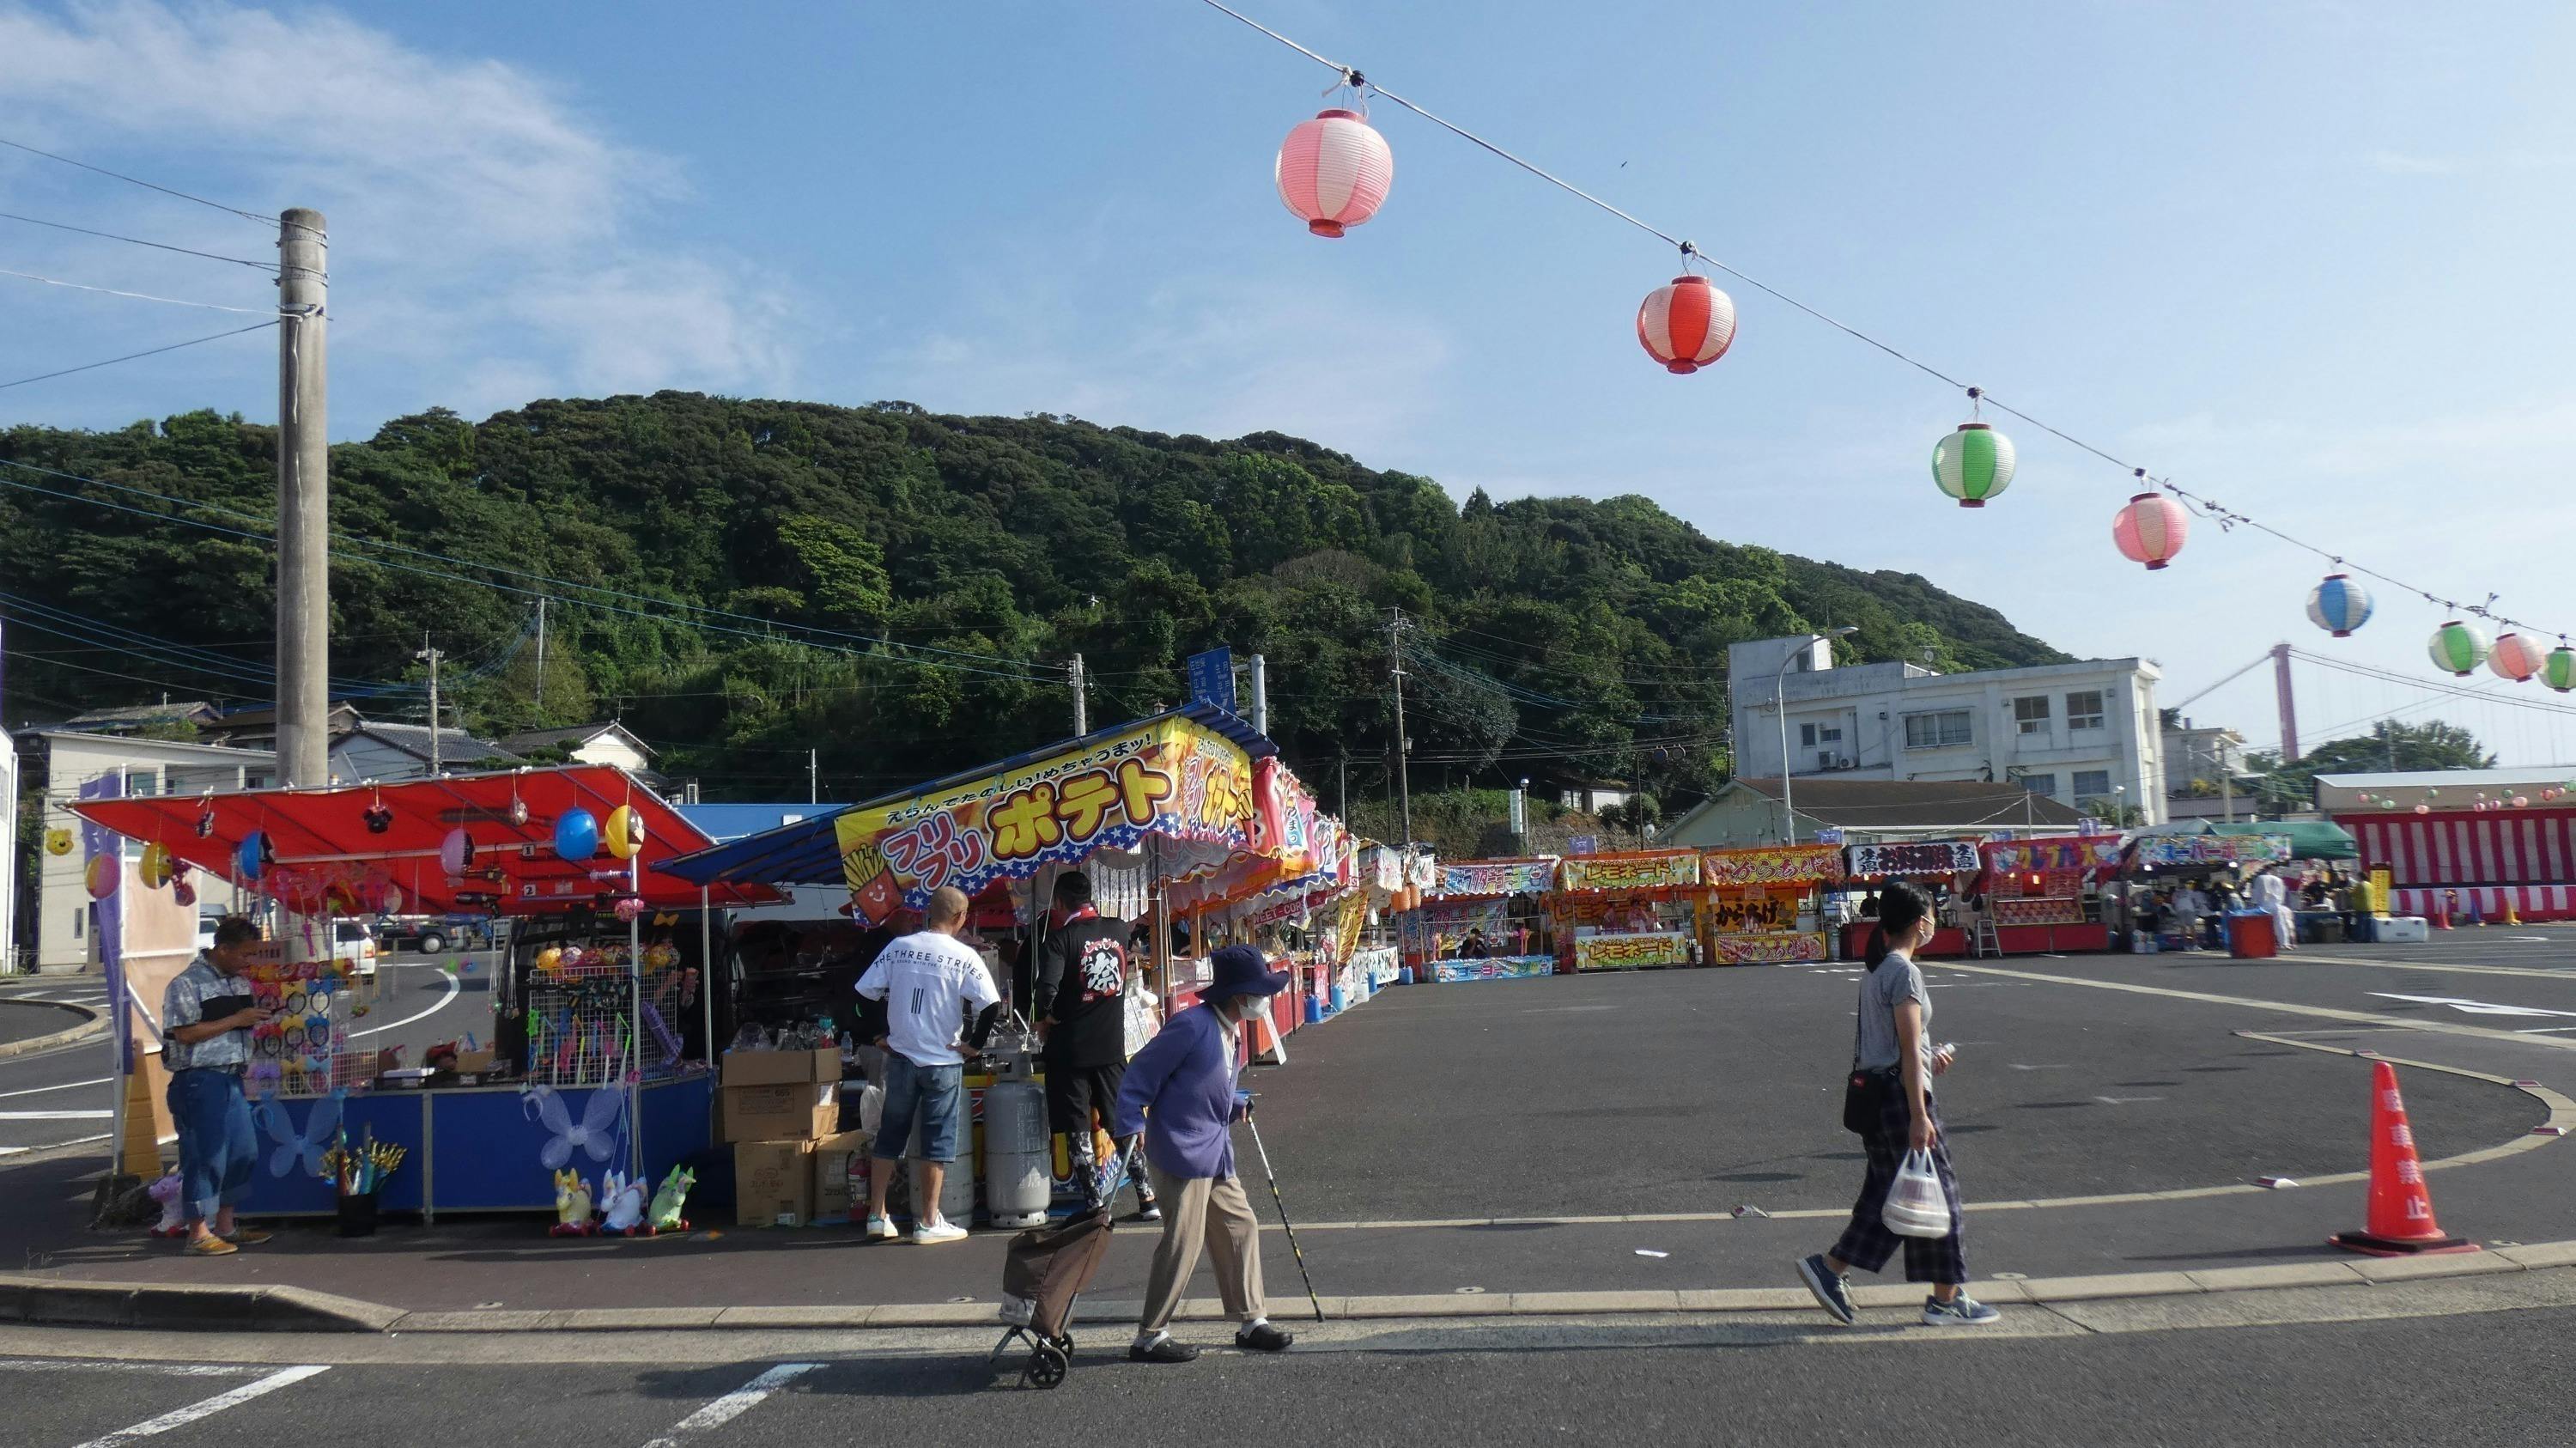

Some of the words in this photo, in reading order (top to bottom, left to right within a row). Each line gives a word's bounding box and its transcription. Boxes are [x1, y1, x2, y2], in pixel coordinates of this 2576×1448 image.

[986, 757, 1173, 861] ポテト
[1585, 861, 1673, 880] レモネード
[526, 886, 533, 895] 2
[1589, 941, 1674, 960] レモネード
[874, 952, 892, 968] THE
[894, 950, 932, 961] THREE
[936, 954, 984, 981] STRIPES
[2382, 1088, 2430, 1220] 駐車禁止
